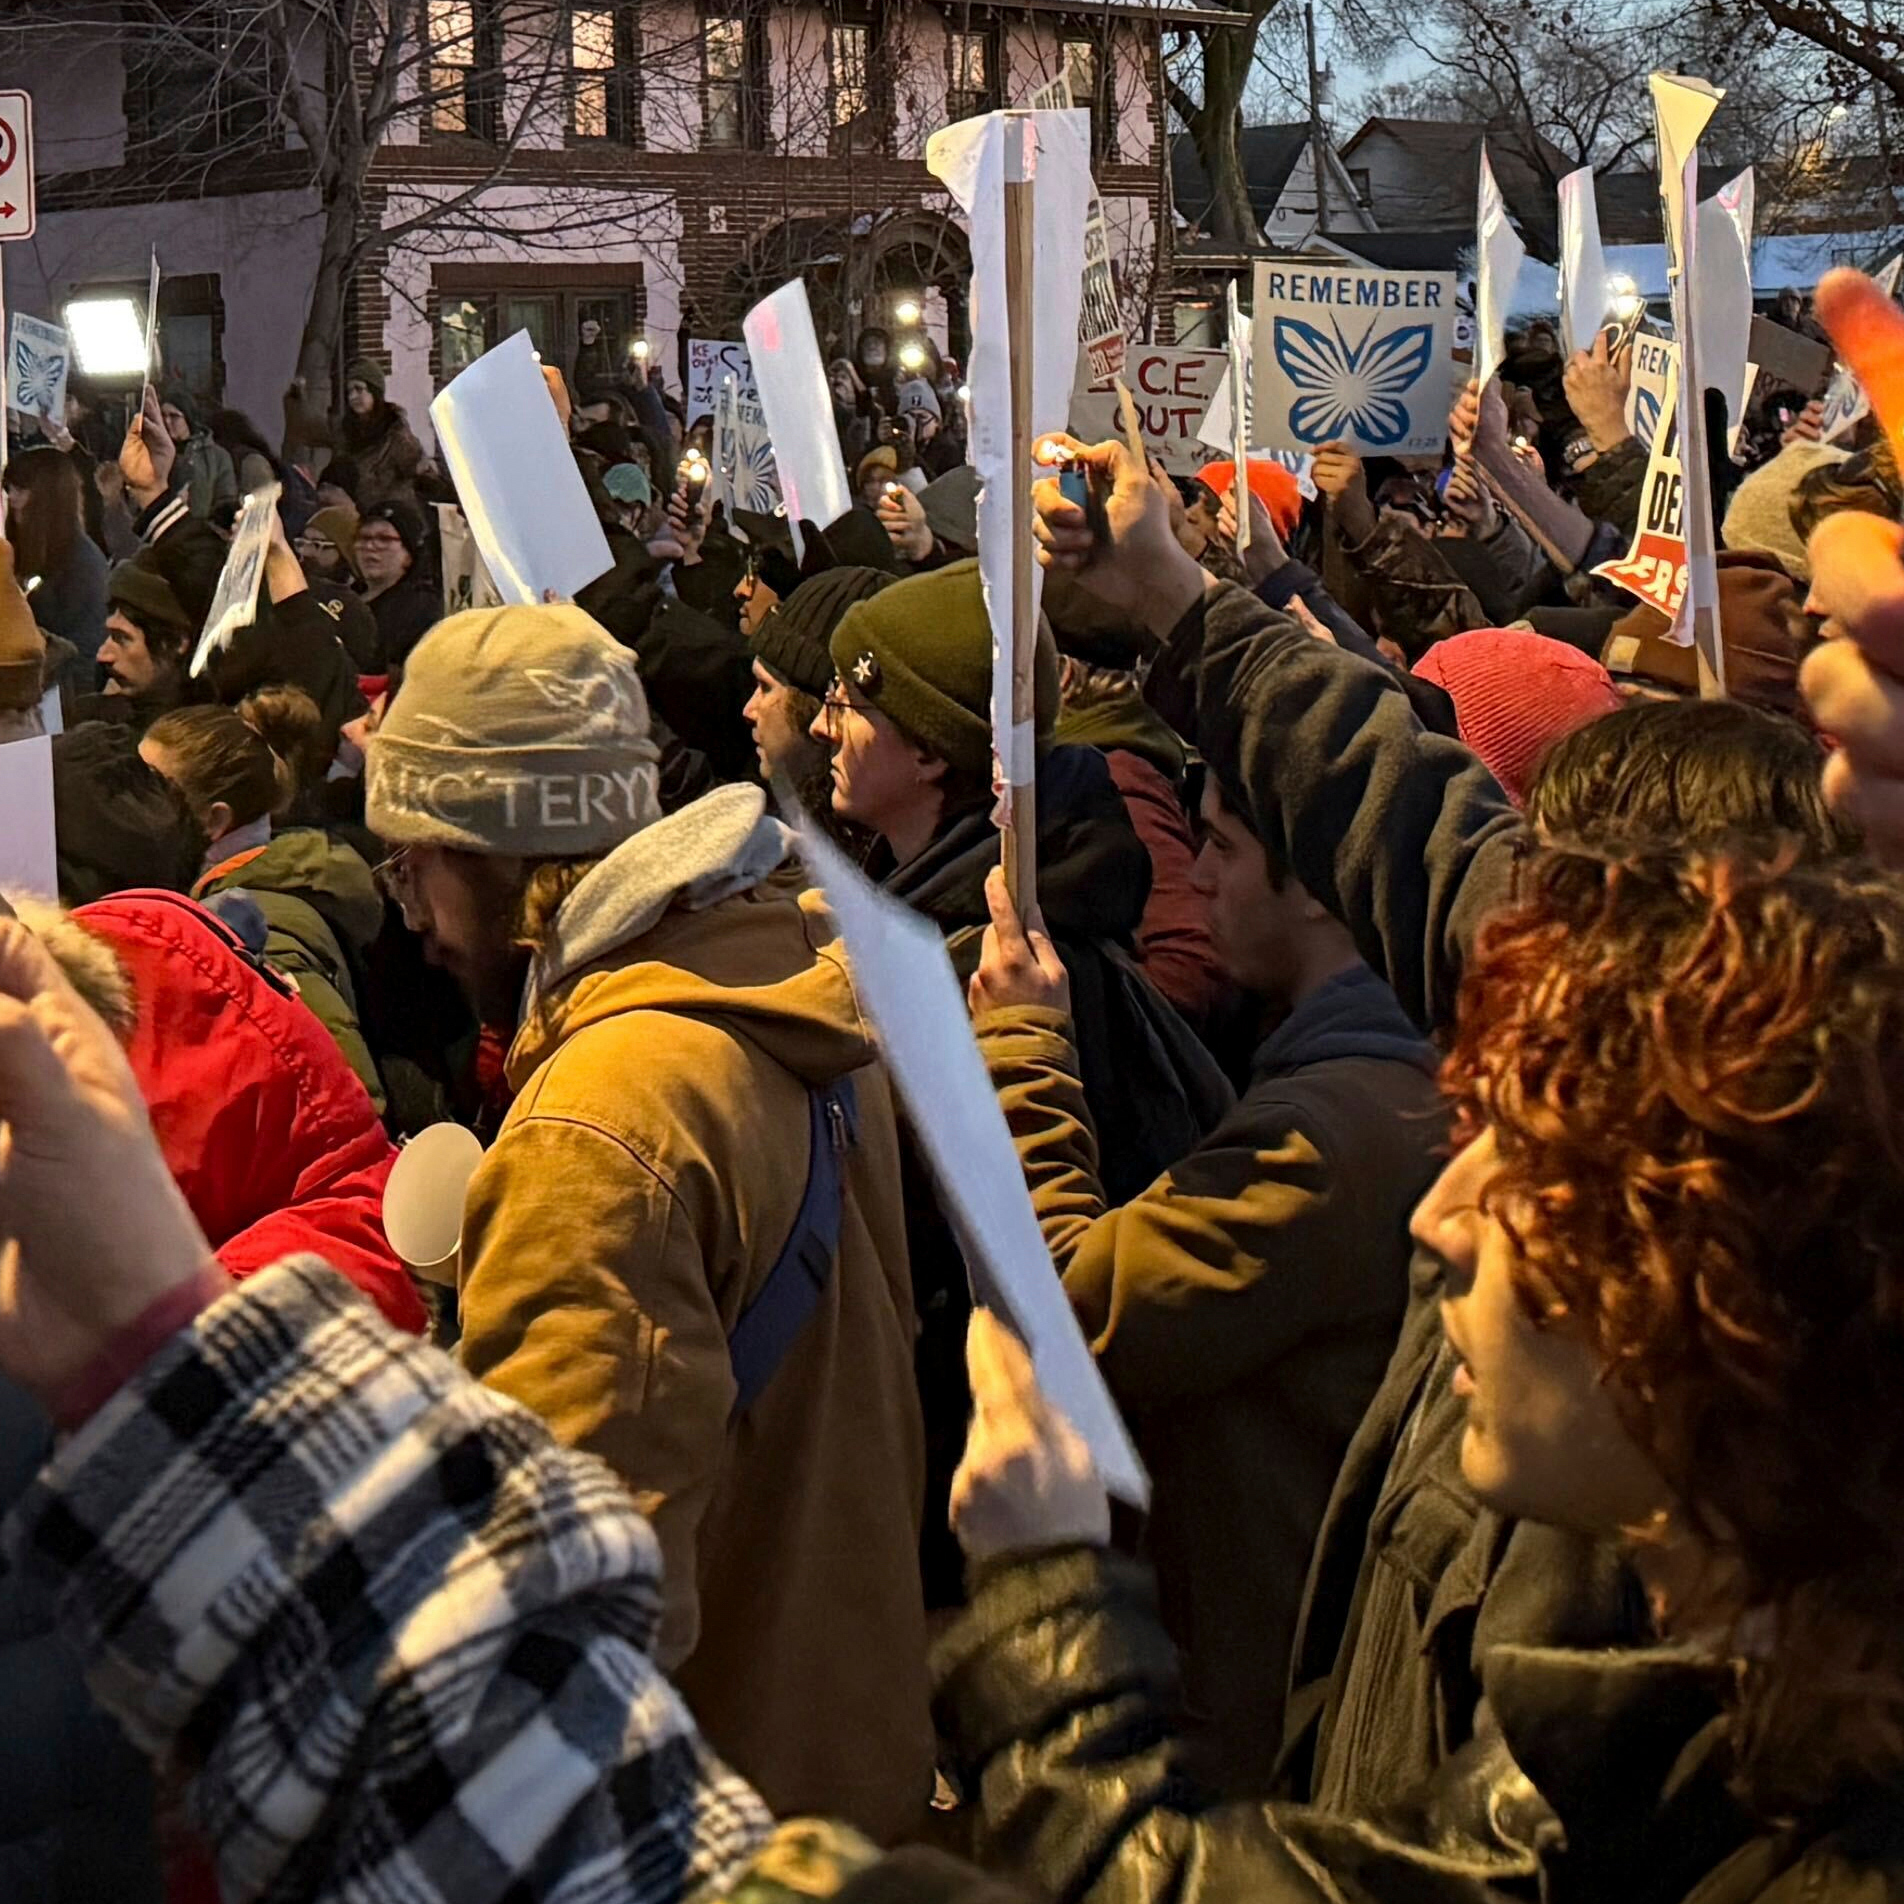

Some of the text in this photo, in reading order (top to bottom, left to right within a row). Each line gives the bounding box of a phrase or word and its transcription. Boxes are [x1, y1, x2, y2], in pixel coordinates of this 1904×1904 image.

[1269, 272, 1442, 308] REMEMBER
[1087, 357, 1209, 400] .C.E.
[1113, 403, 1203, 439] OUT
